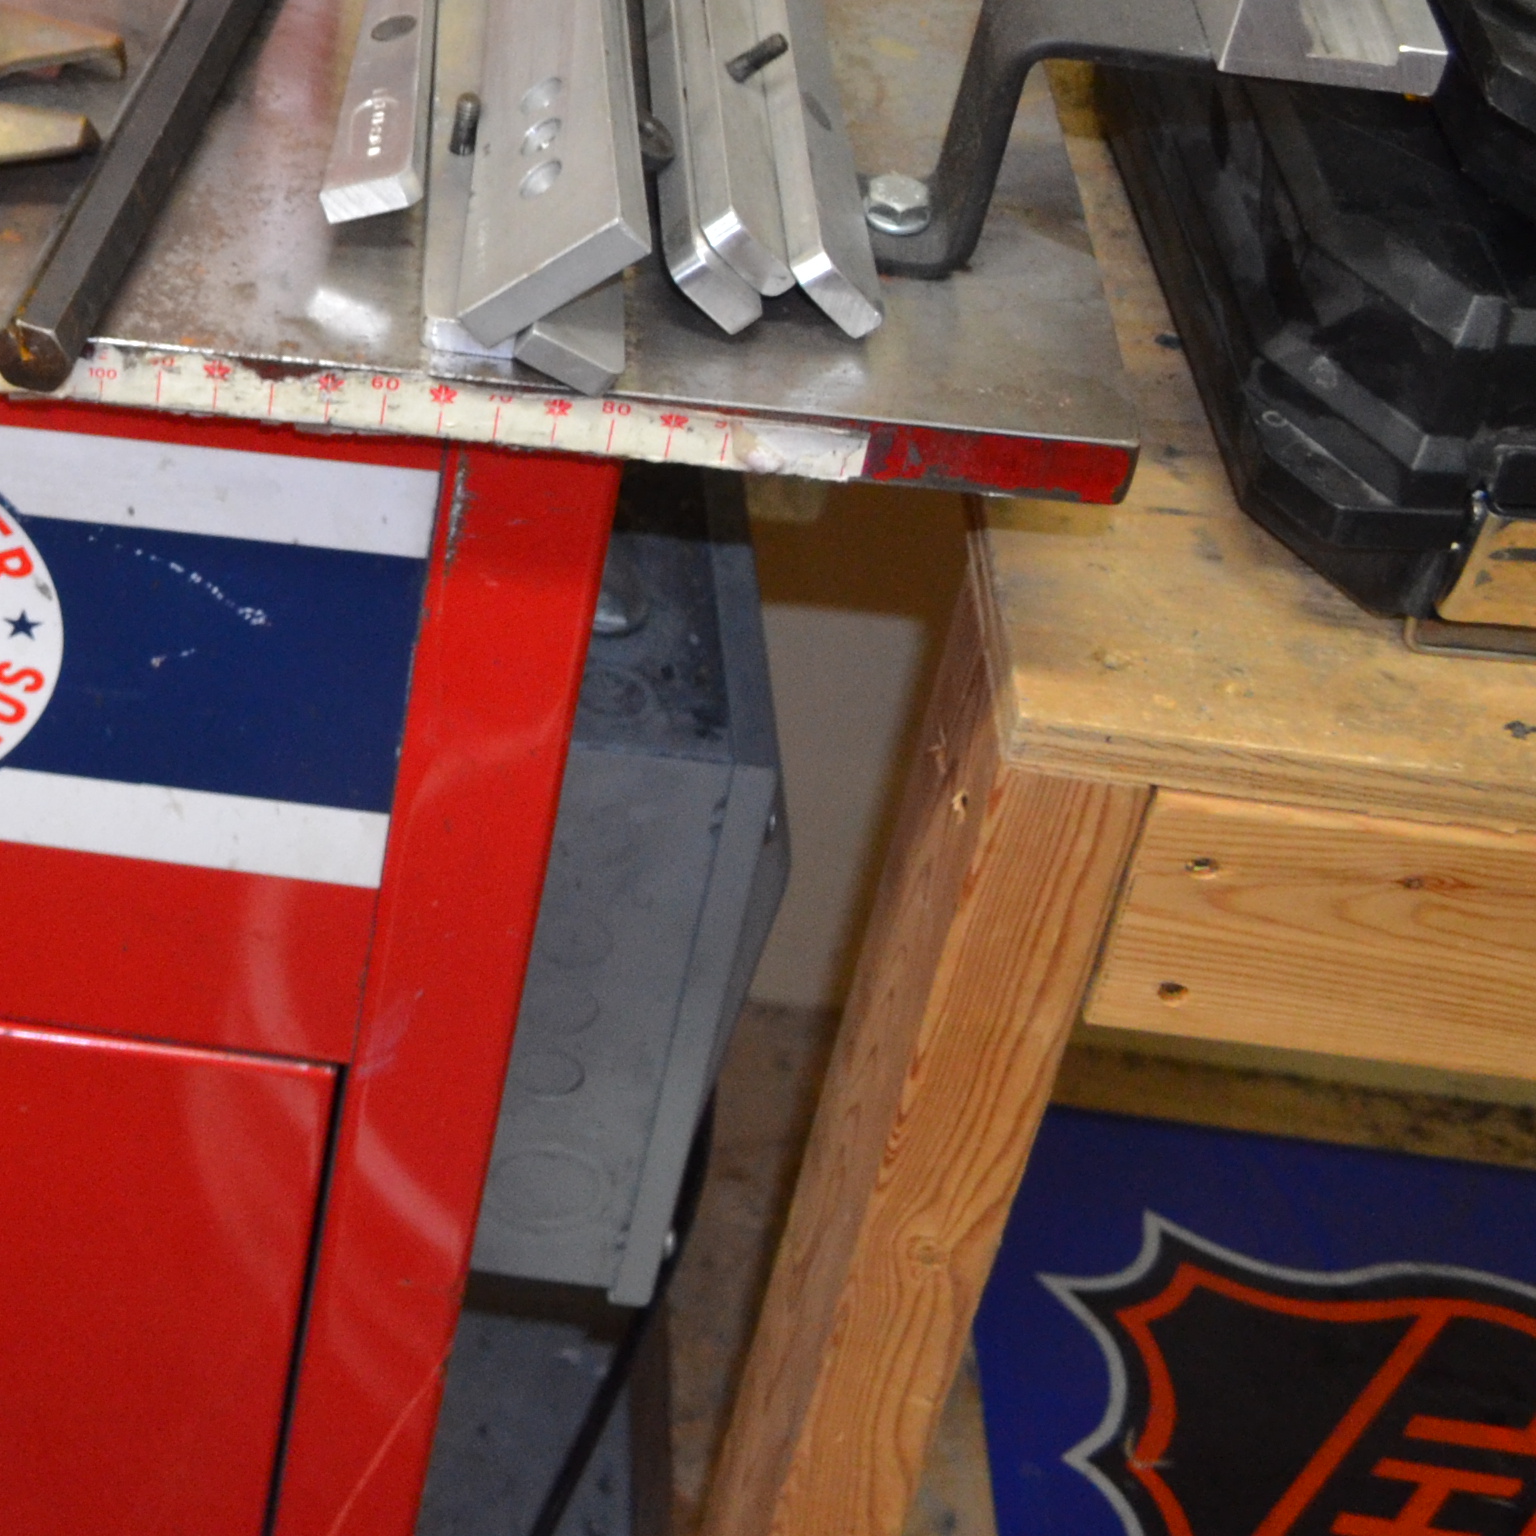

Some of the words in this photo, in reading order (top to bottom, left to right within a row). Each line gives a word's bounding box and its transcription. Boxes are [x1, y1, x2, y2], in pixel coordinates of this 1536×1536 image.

[88, 367, 118, 380] 100
[371, 375, 401, 392] 60
[602, 400, 632, 416] 80
